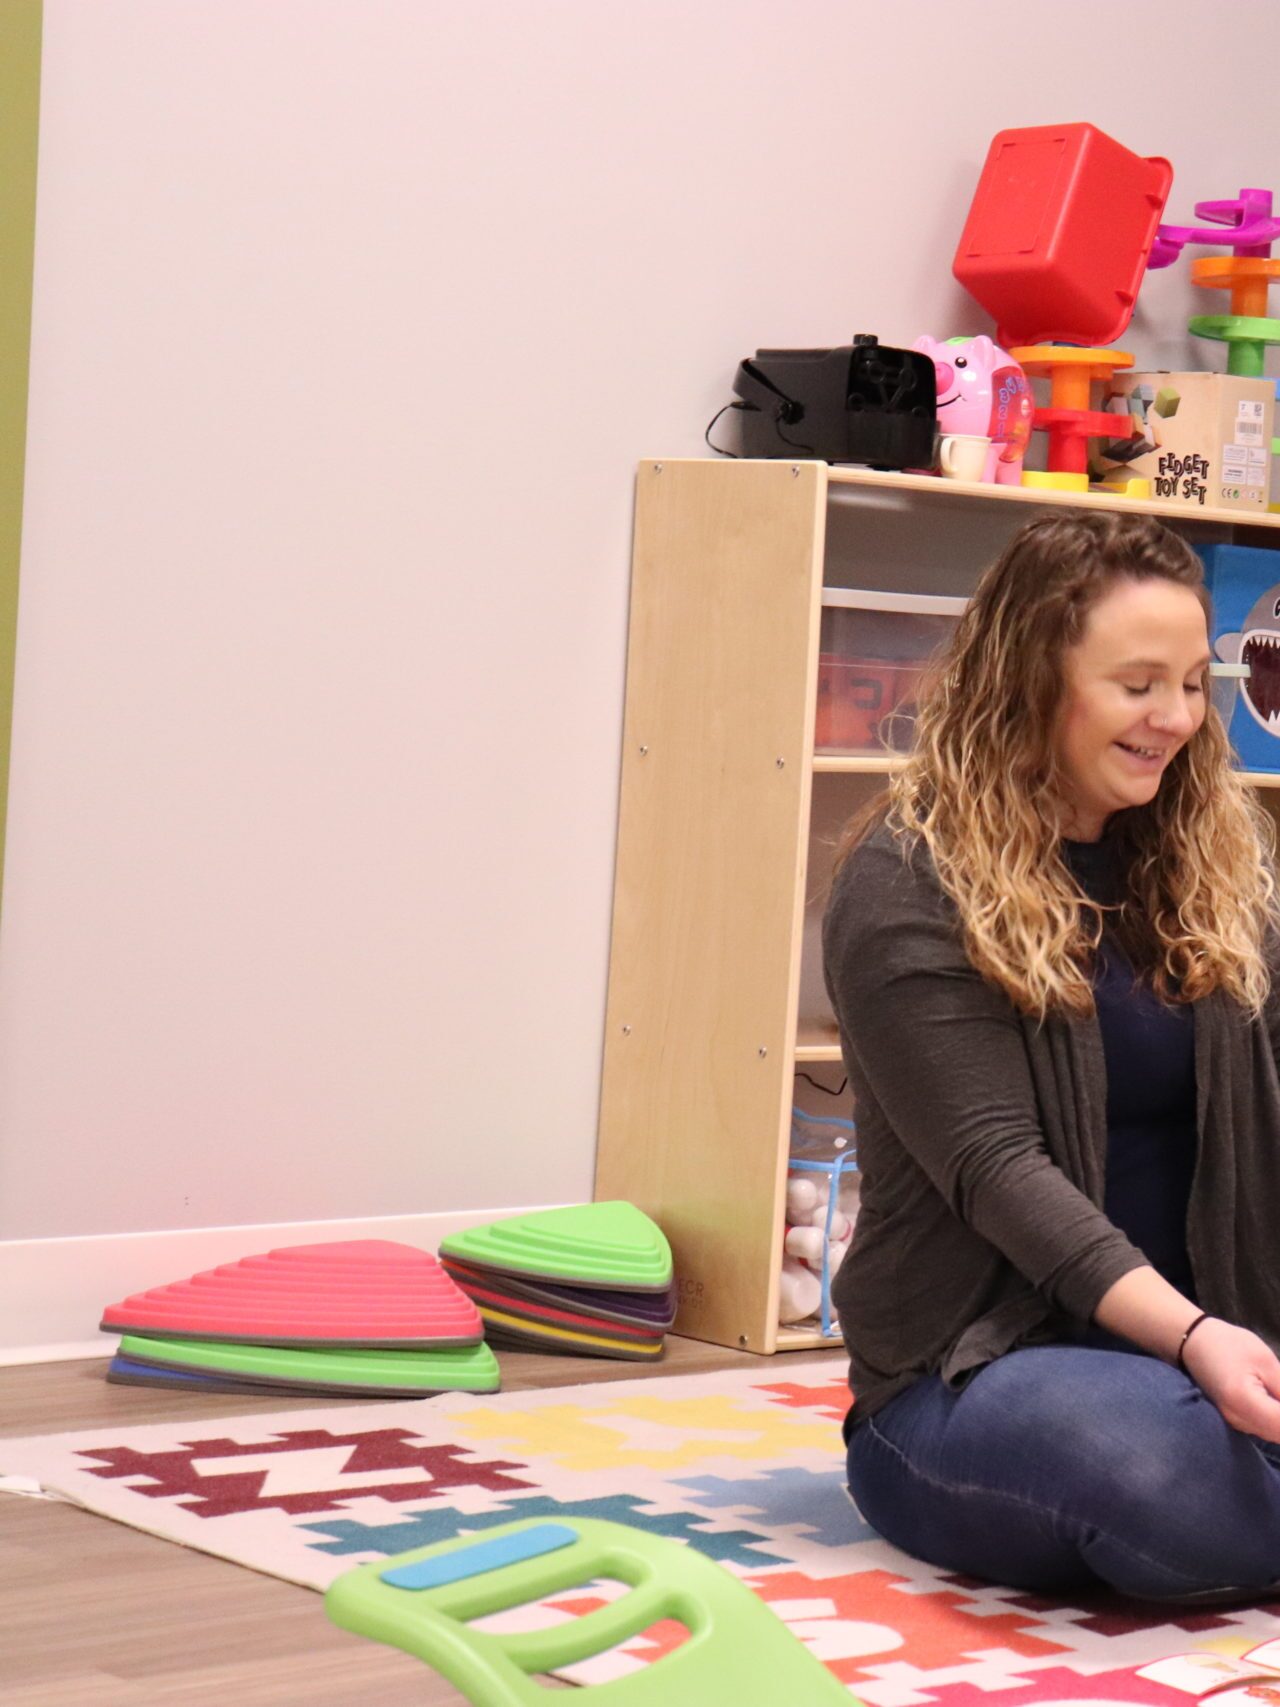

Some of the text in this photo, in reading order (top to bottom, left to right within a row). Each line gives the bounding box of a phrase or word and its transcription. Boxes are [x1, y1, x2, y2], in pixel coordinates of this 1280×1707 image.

[1158, 452, 1209, 479] FIDGET
[1154, 476, 1207, 505] TOY SET
